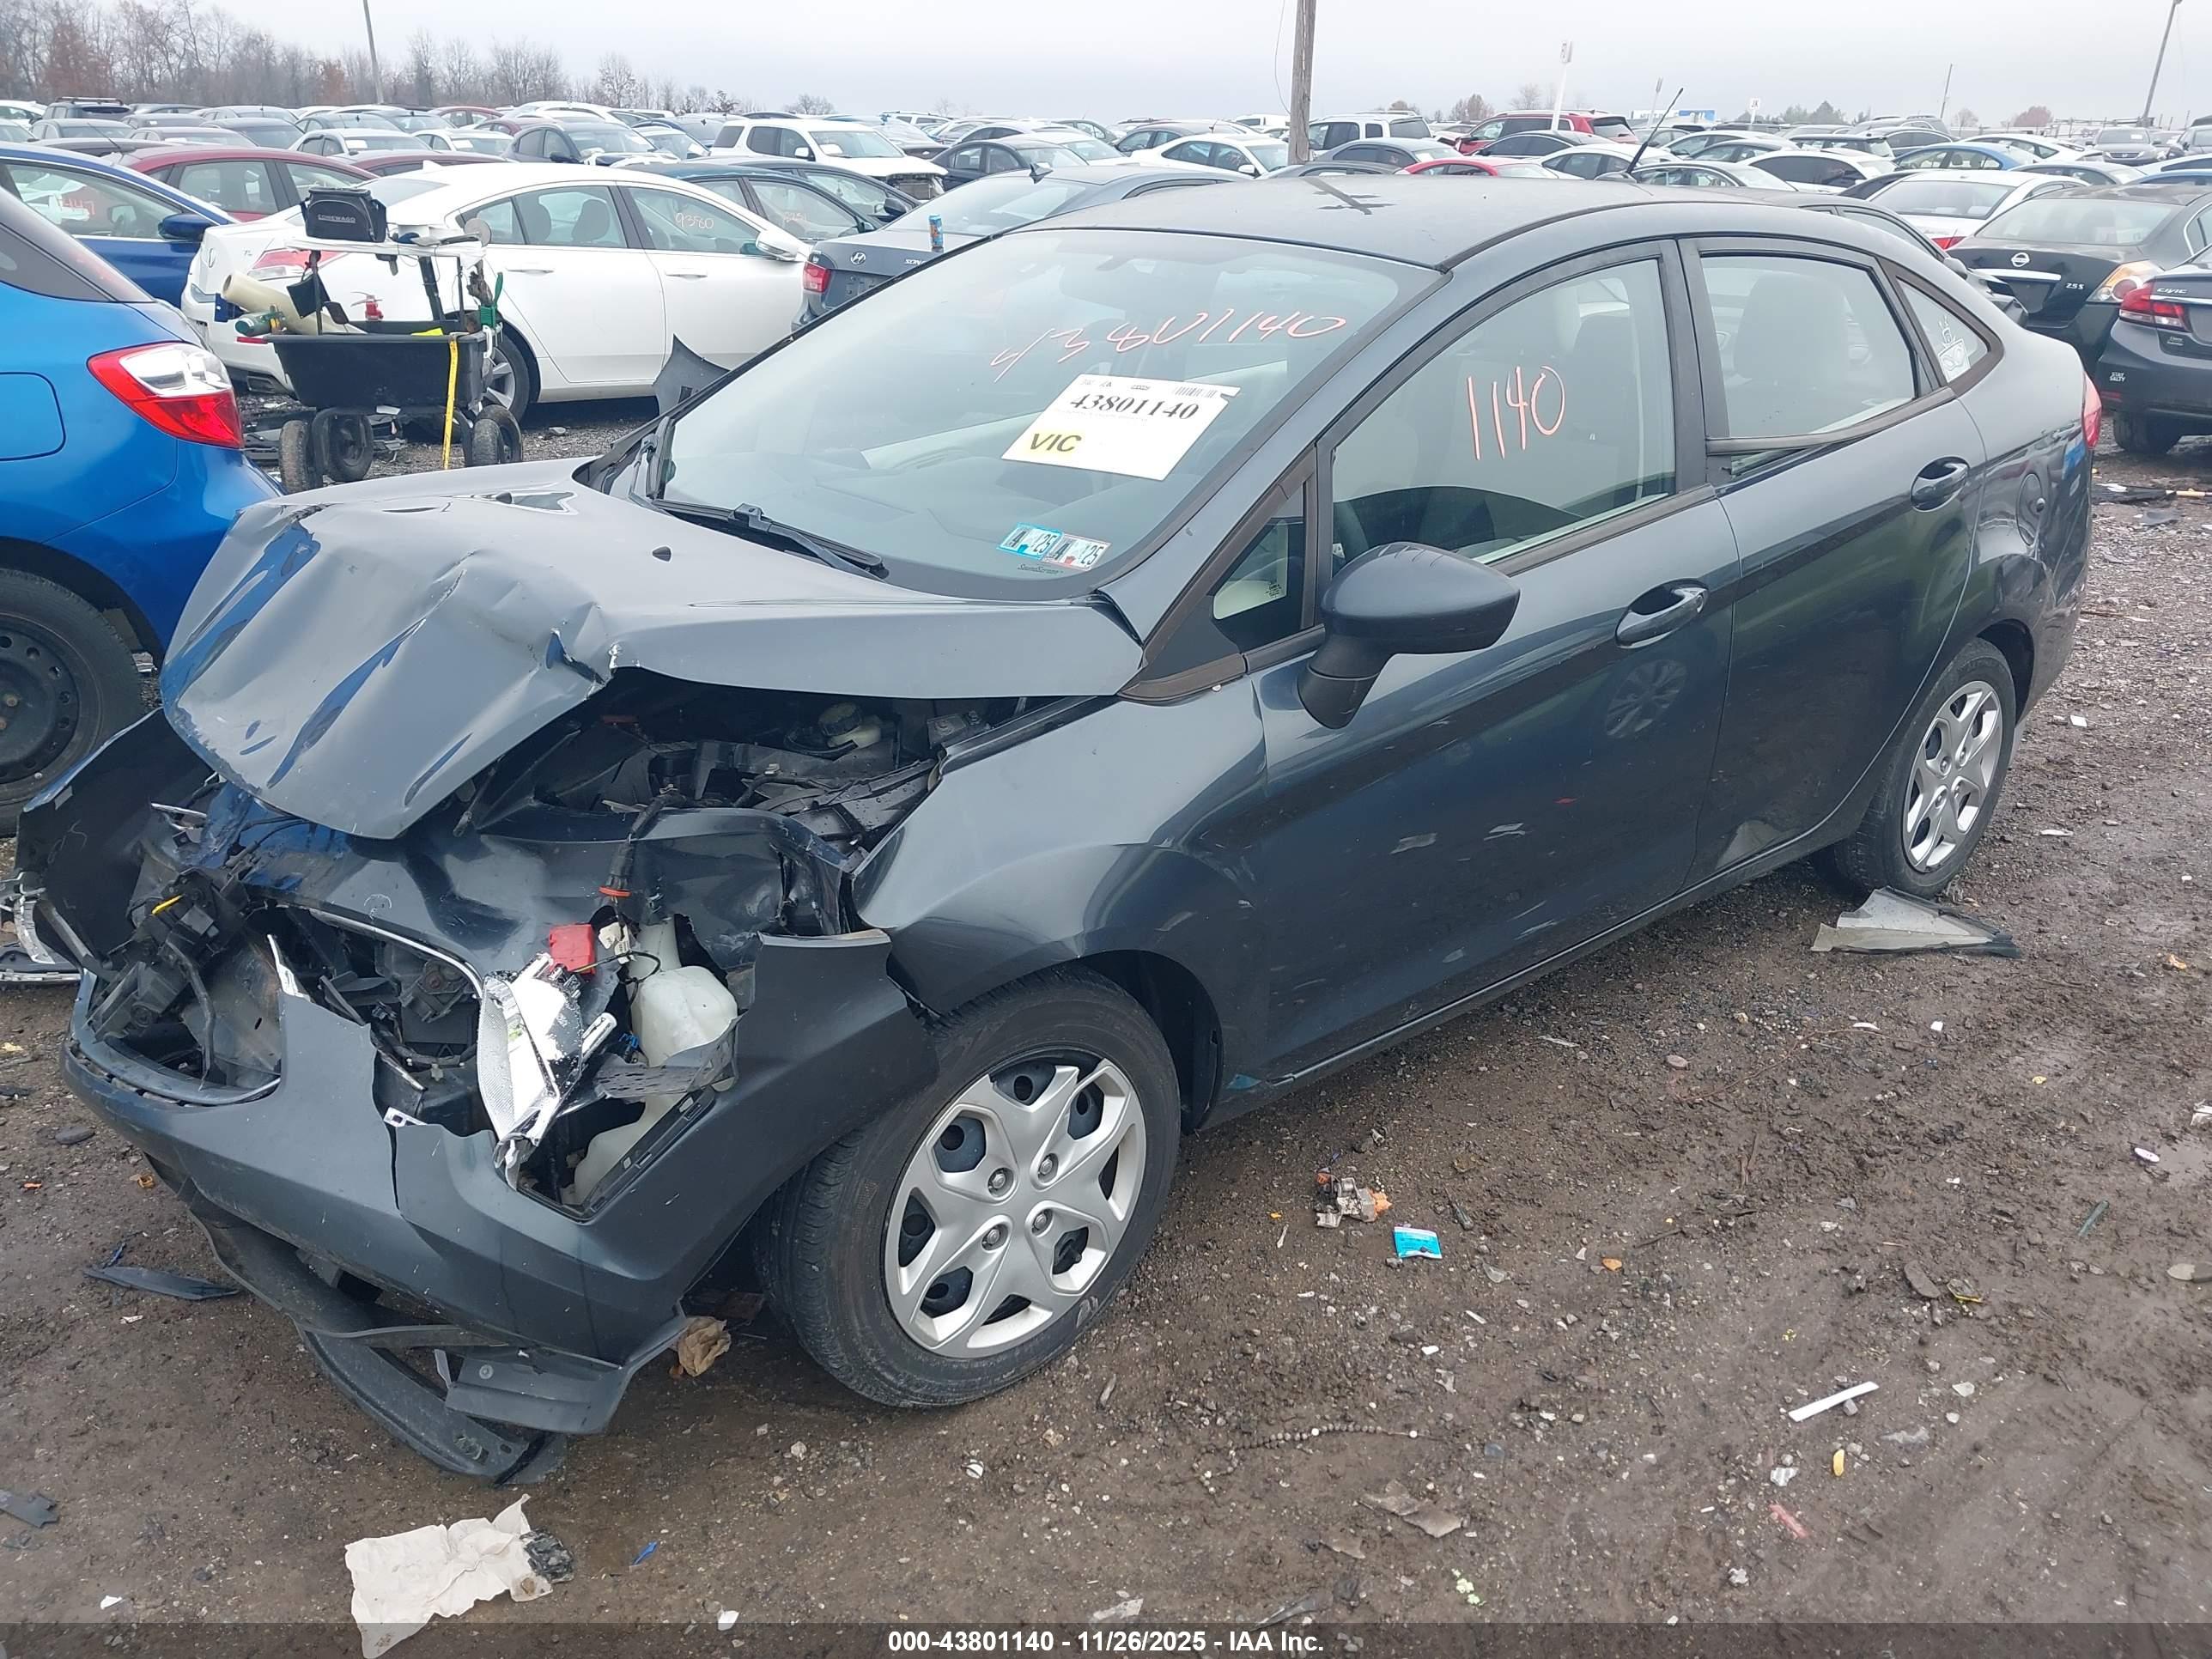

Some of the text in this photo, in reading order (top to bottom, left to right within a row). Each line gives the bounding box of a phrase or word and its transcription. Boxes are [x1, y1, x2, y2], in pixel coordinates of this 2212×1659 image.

[1070, 393, 1200, 420] 43801140
[1467, 366, 1565, 460] 1140
[1030, 433, 1082, 453] VIC
